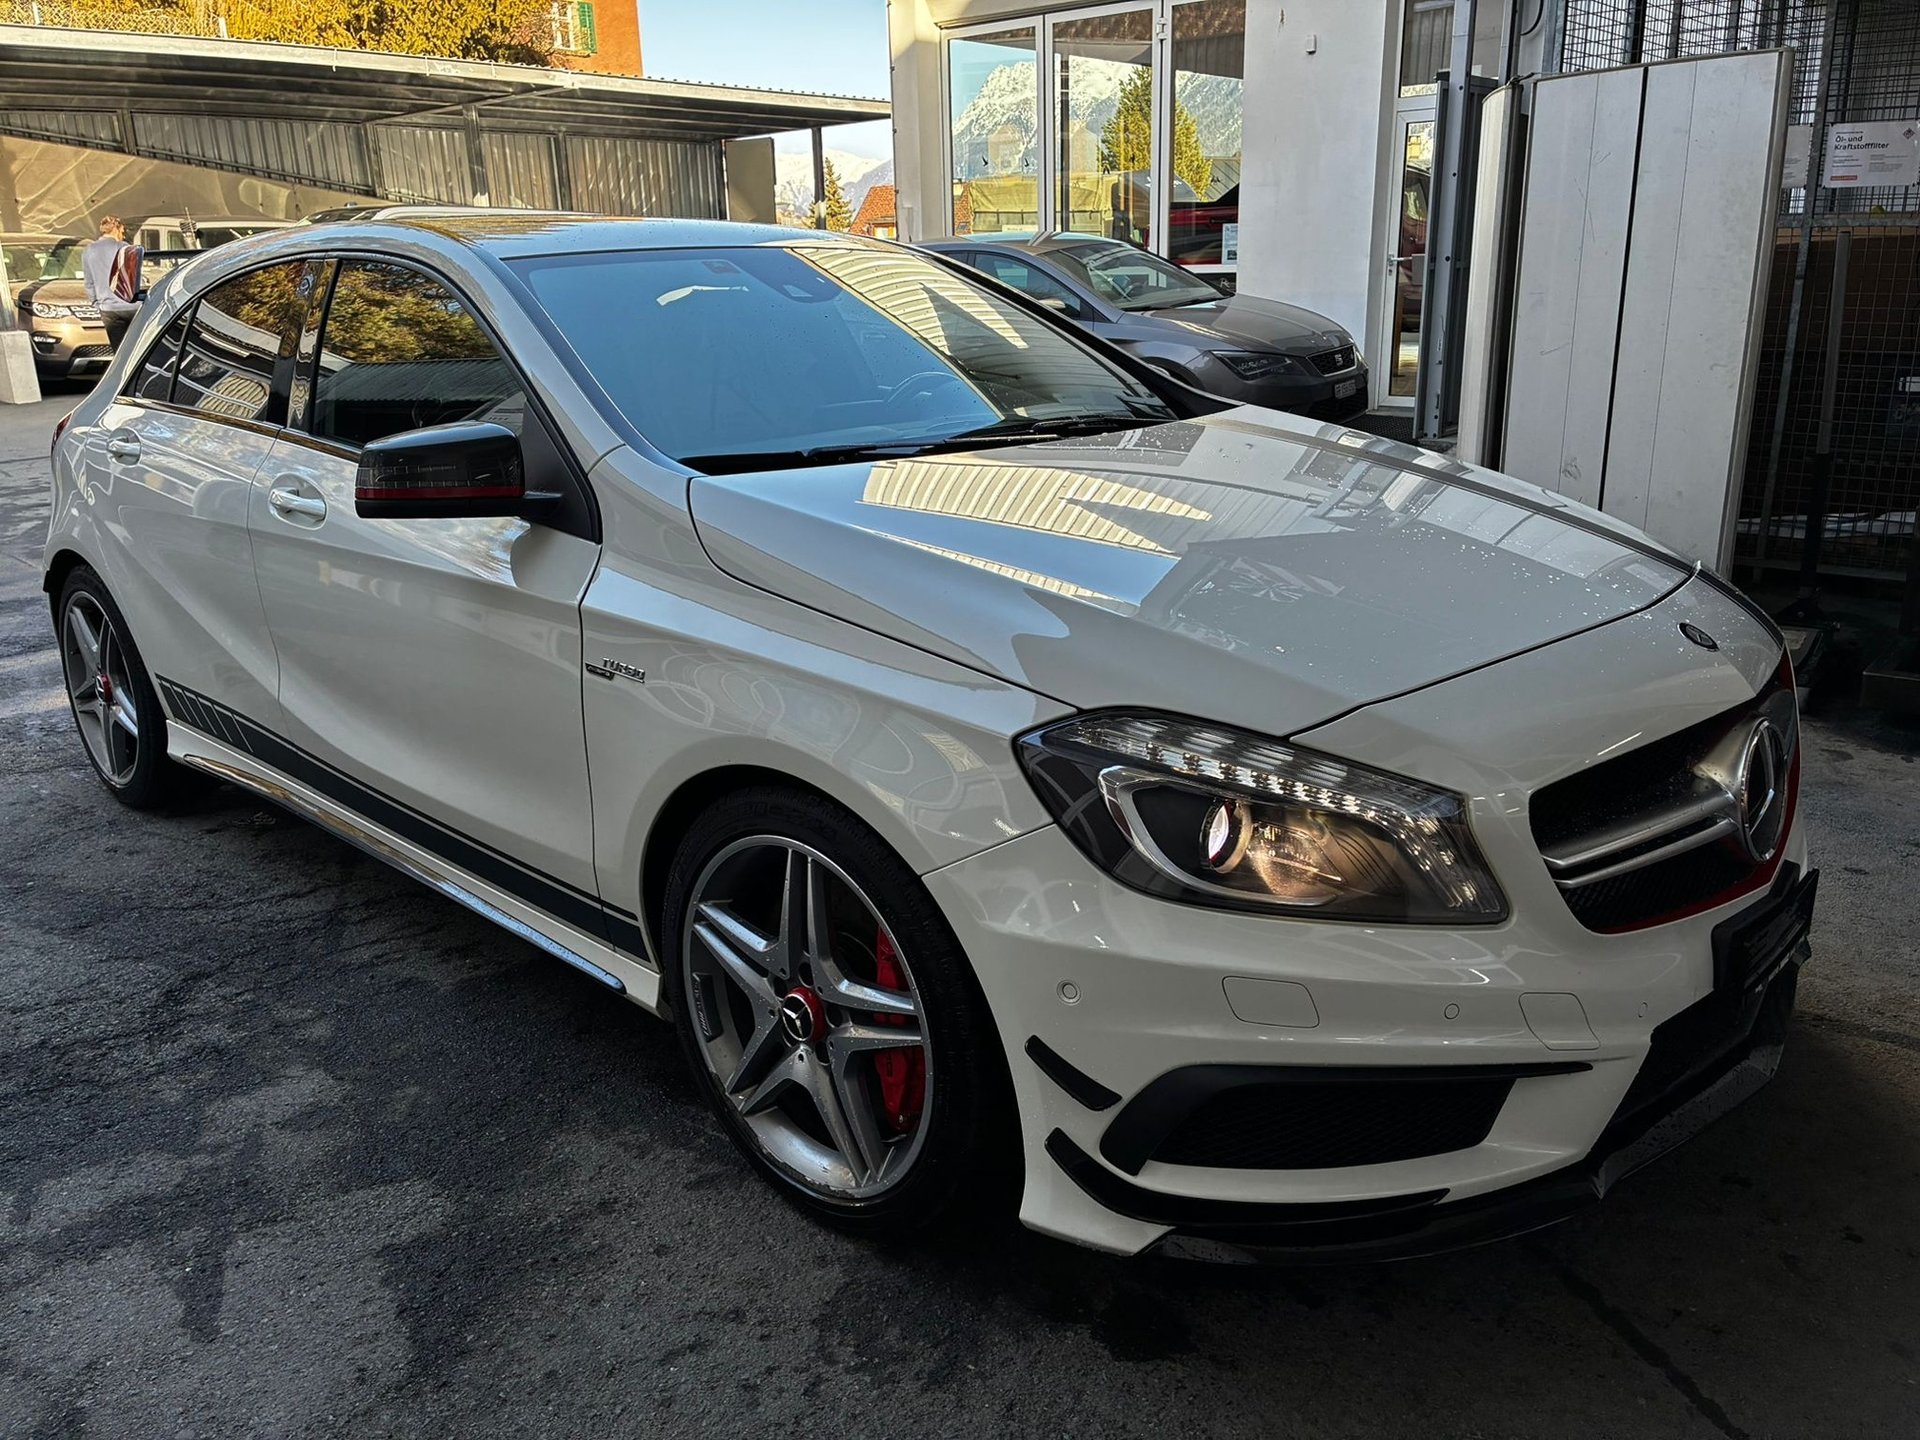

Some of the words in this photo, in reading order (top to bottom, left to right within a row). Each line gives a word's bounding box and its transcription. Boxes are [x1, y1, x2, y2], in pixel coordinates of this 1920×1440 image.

[1835, 135, 1847, 143] Öl-
[1834, 142, 1889, 151] Kraftstofffilter
[602, 657, 645, 680] TURBO
